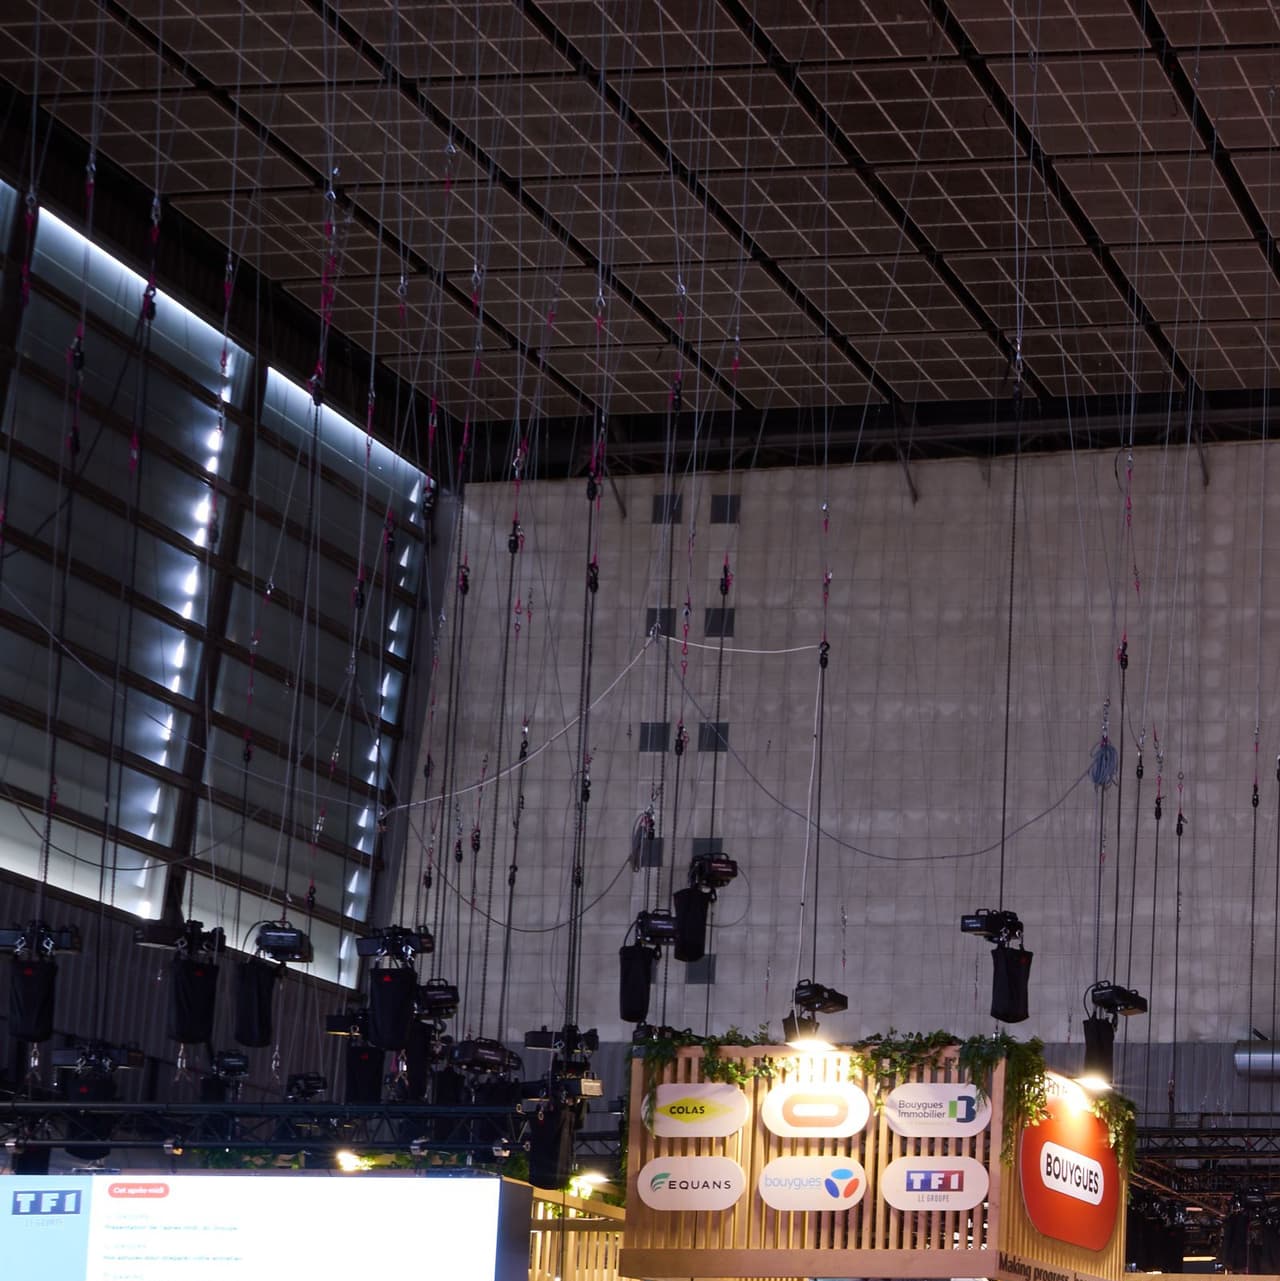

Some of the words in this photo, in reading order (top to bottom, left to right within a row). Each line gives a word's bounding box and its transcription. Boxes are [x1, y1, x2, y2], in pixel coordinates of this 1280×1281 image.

[669, 1106, 705, 1115] COLAS
[898, 1100, 944, 1110] Bouygues
[898, 1110, 946, 1118] Immobilier
[1046, 1152, 1099, 1195] BOUYGUES
[669, 1180, 732, 1190] EQUANS
[764, 1174, 822, 1190] bouygues
[910, 1173, 960, 1190] TF1
[16, 1192, 78, 1213] TF1
